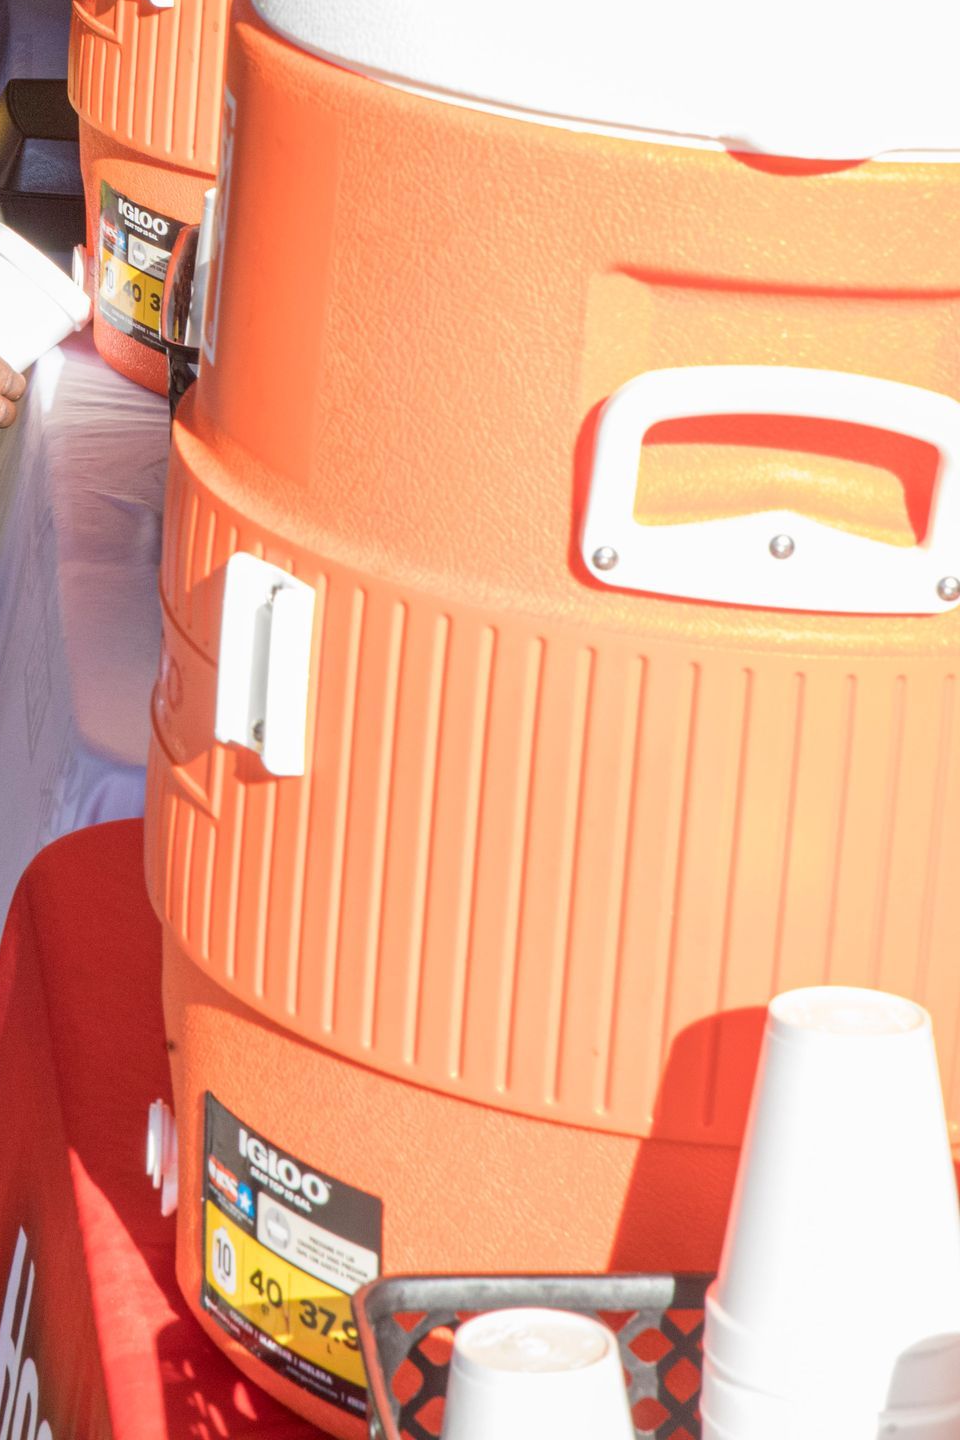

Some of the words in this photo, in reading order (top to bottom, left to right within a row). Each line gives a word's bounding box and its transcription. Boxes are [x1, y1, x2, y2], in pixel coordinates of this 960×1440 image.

[118, 197, 168, 235] IGLOO
[123, 280, 142, 303] 40
[239, 1127, 330, 1206] IGLOO
[213, 1236, 231, 1280] 10
[249, 1269, 283, 1309] 40
